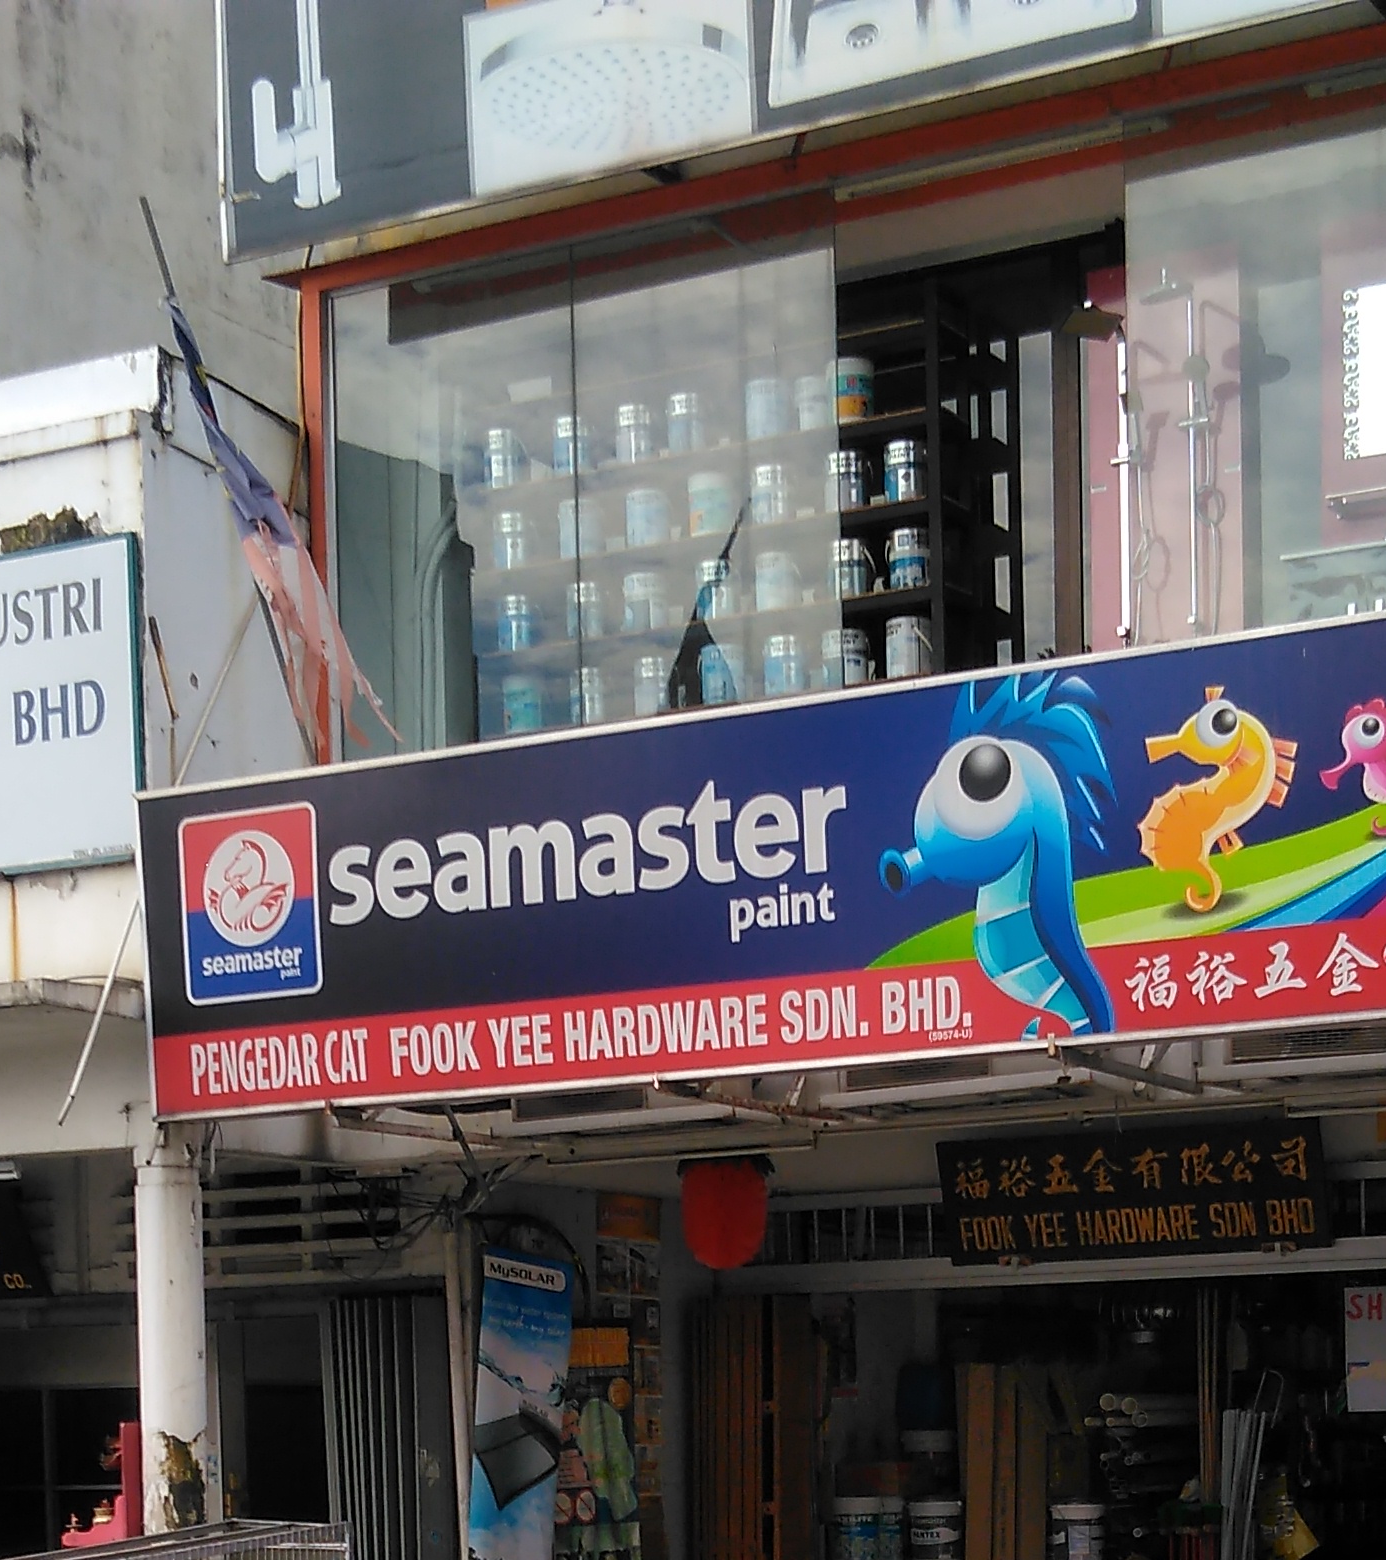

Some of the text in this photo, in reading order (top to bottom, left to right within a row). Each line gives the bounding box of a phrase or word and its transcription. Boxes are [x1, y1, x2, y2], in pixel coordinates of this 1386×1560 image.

[13, 678, 107, 747] BHD
[326, 778, 848, 928] seamaster
[729, 883, 837, 943] paint
[201, 945, 305, 981] seamaster paint
[190, 976, 974, 1097] PENGEDAR CAT FOOK YEE HARDWARE SDN. BHD.
[959, 1197, 1316, 1253] FOOK YEE HARDWARE SDN BHD
[489, 1261, 556, 1286] MySOLAR
